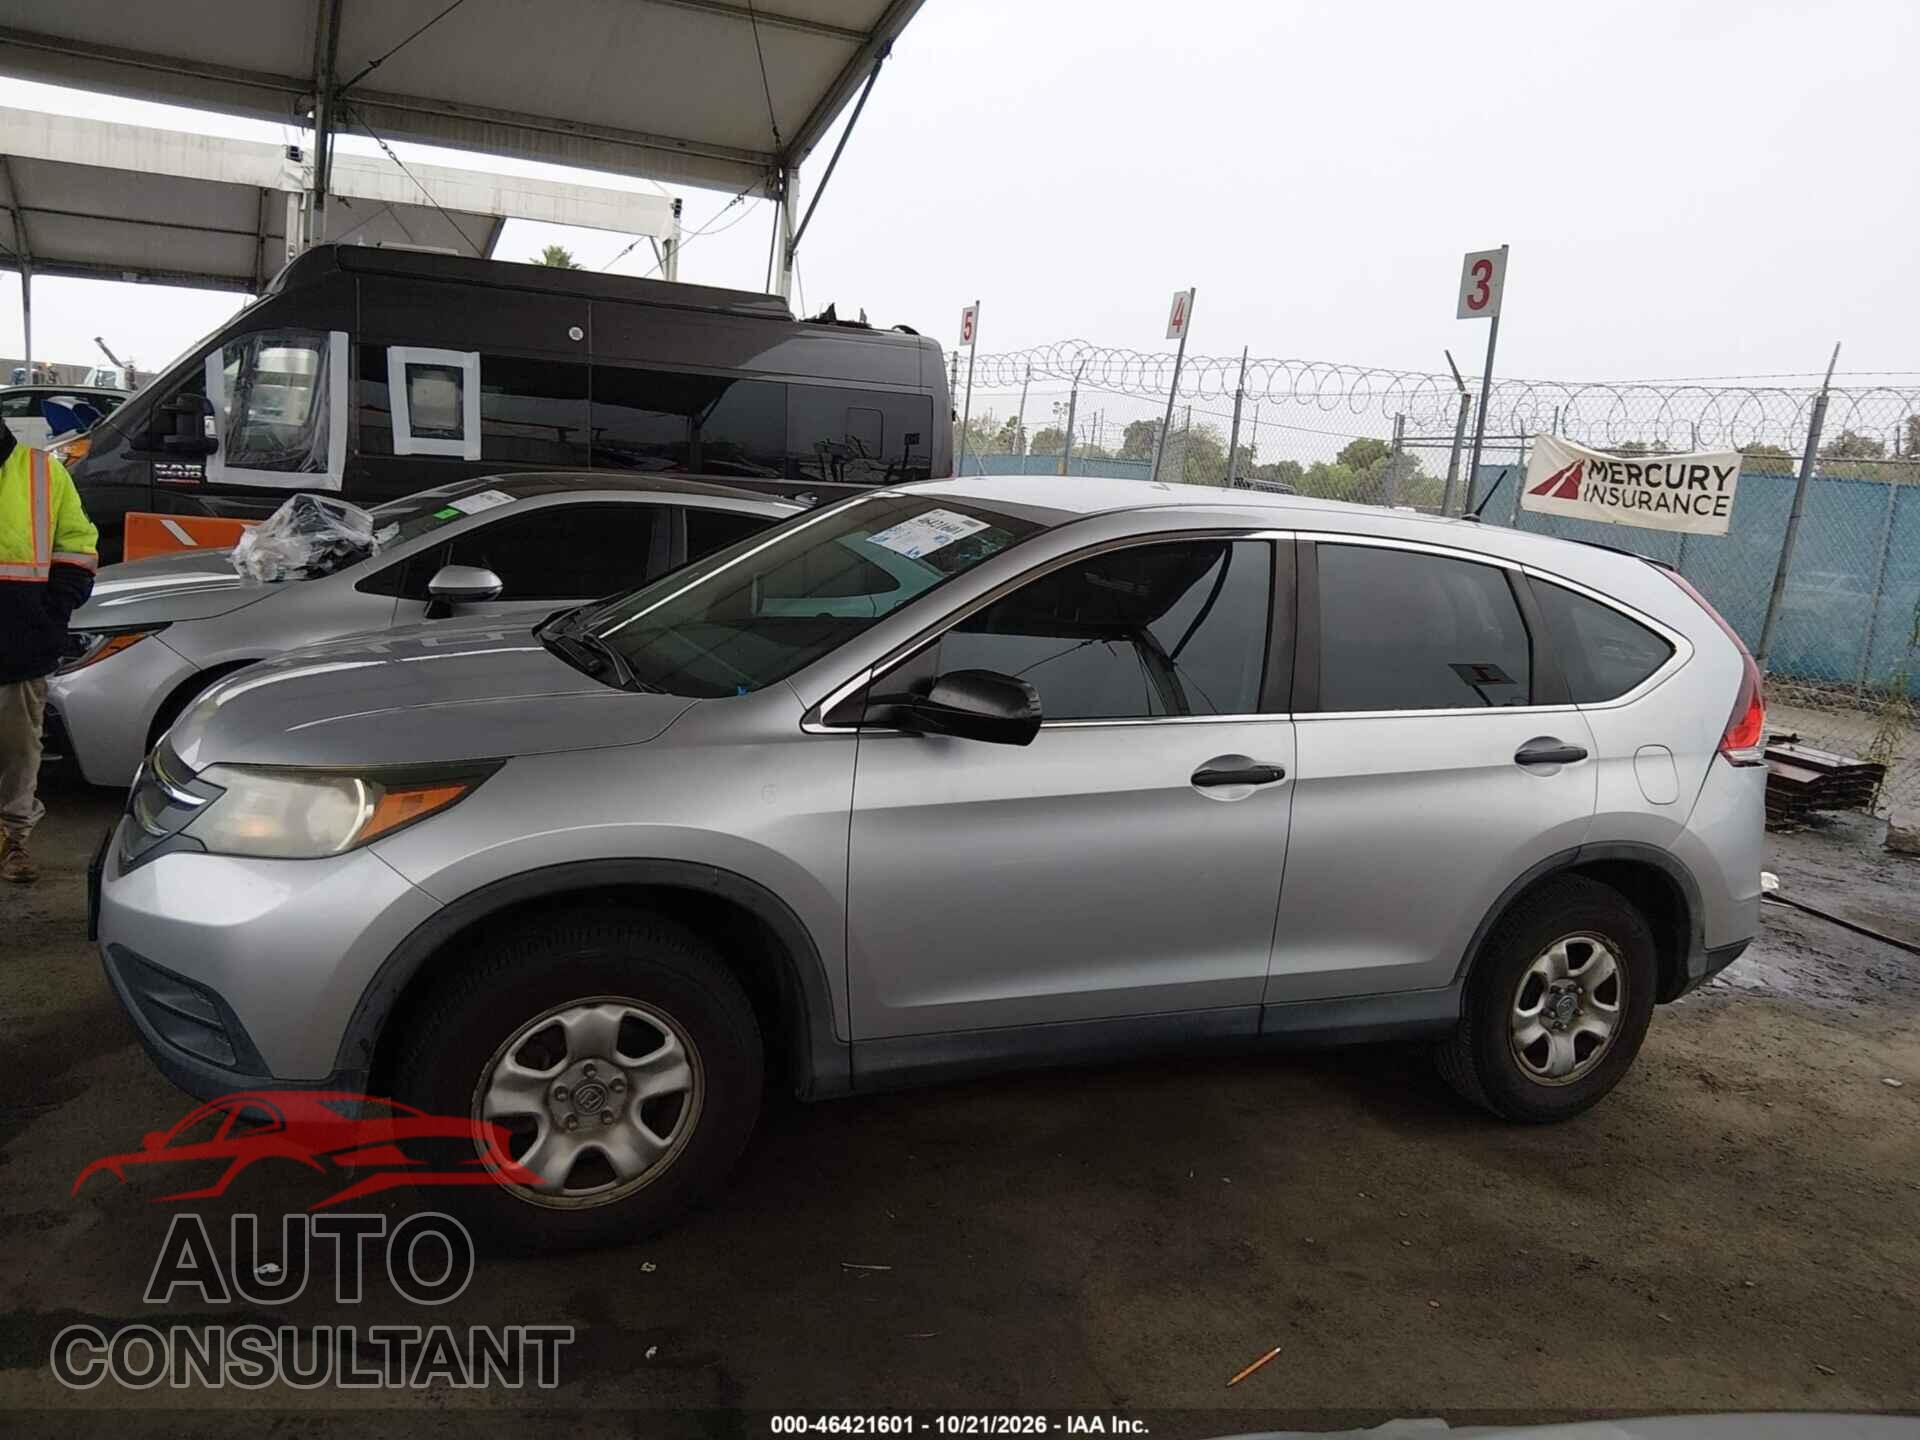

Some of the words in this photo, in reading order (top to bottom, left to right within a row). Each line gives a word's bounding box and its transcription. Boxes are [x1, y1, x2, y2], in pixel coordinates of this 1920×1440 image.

[1467, 259, 1492, 310] 3
[964, 311, 973, 341] 5
[1172, 297, 1184, 333] 4
[1588, 459, 1736, 491] MERCURY
[1583, 483, 1730, 516] INSURANCE
